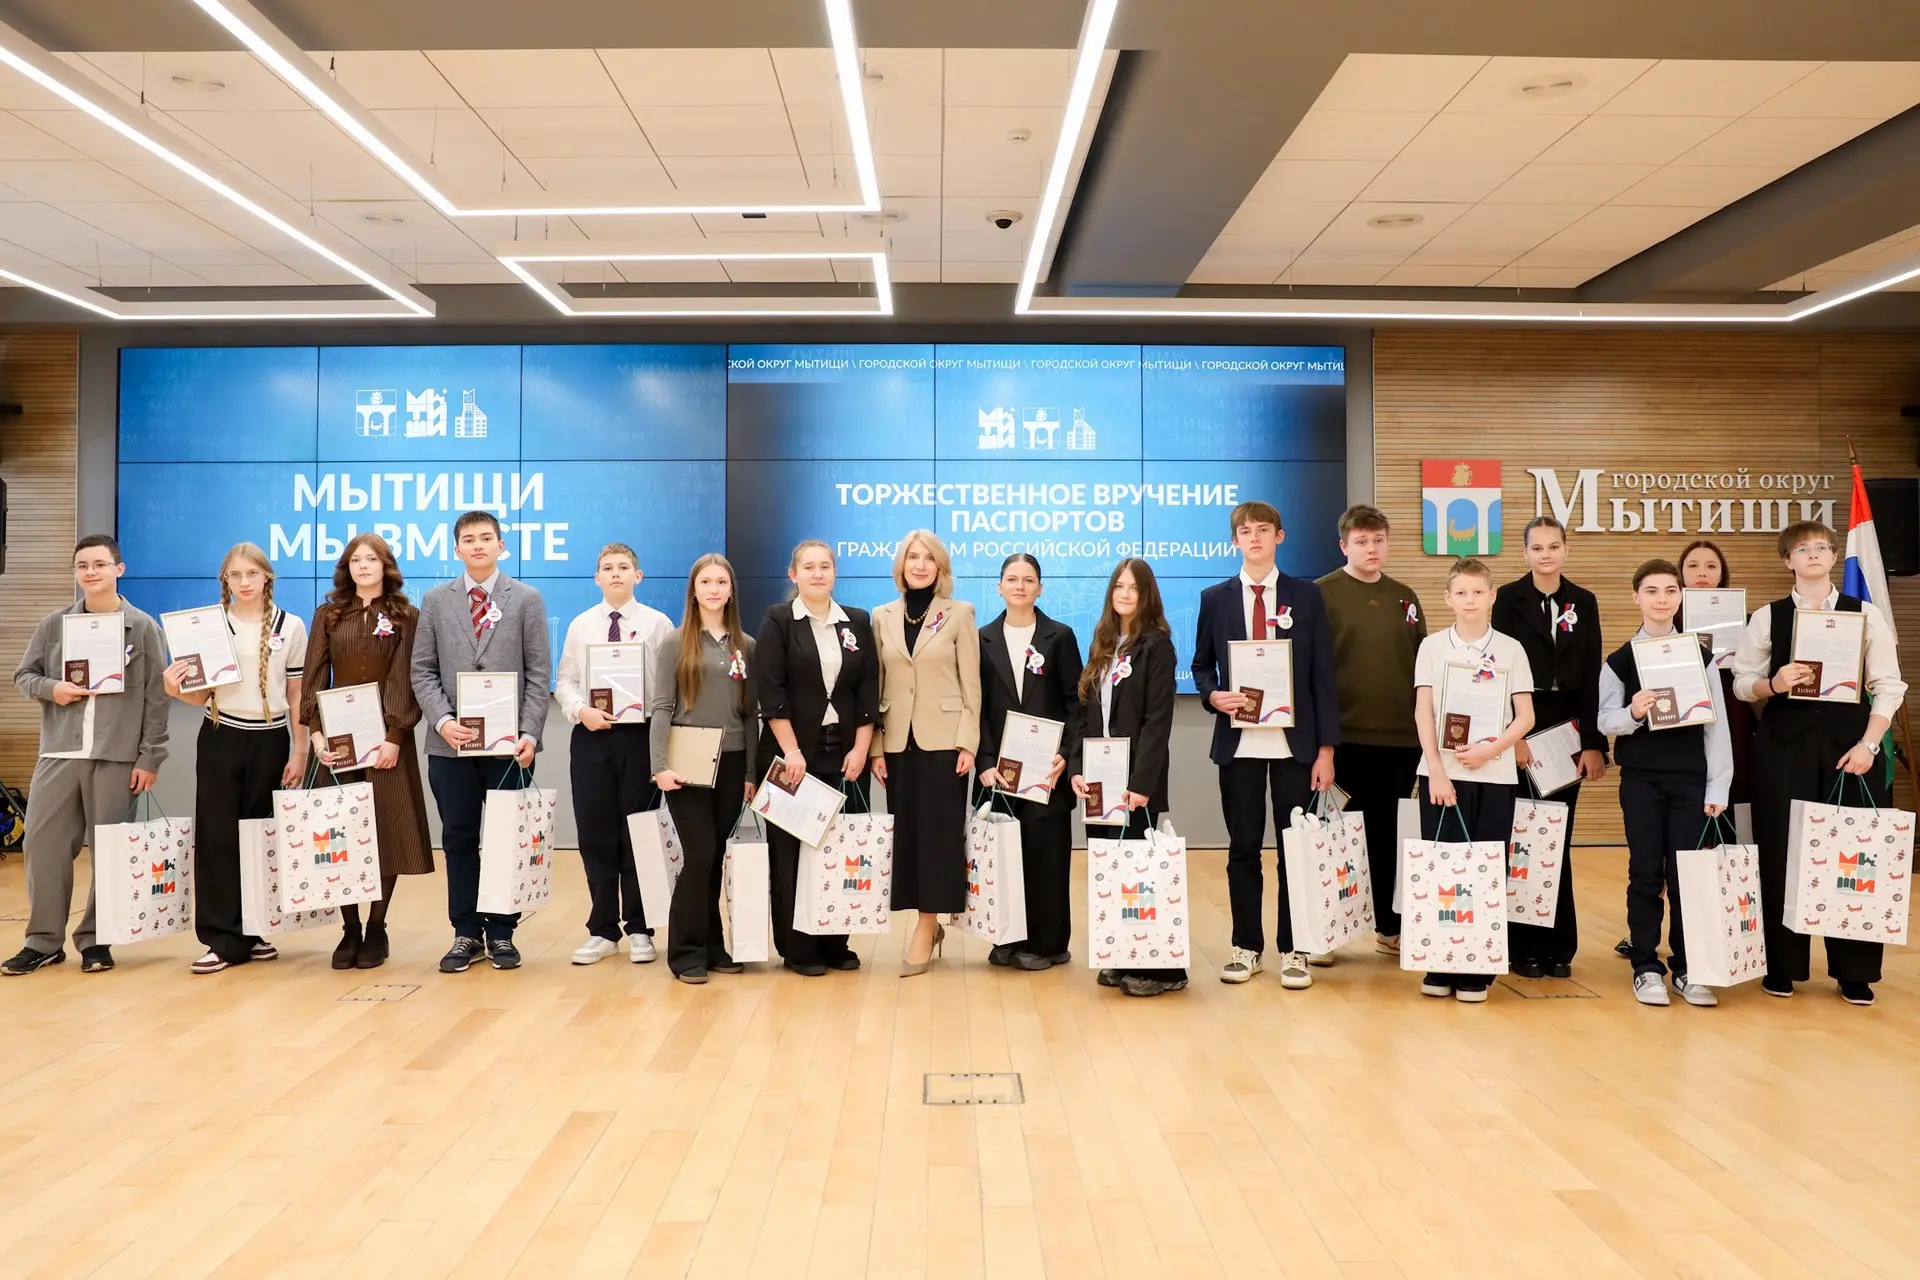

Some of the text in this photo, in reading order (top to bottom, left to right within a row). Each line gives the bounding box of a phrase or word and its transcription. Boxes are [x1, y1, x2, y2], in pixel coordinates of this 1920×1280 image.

[757, 359, 792, 369] ОКРУГ
[795, 360, 848, 371] МЫТИЩИ
[859, 358, 926, 371] ГОРОДСКОЙ
[932, 360, 963, 369] ОКРУГ
[967, 360, 1020, 371] МЫТИЩИ
[1031, 358, 1098, 371] ГОРОДСКОЙ
[1101, 360, 1135, 370] ОКРУГ
[1138, 361, 1192, 372] МЫТИЩИ
[1202, 359, 1268, 372] ГОРОДСКОЙ
[1271, 361, 1305, 371] ОКРУГ
[1612, 467, 1835, 495] городской округ
[294, 472, 544, 518] МЫТИЩИ
[836, 484, 1239, 506] ТОРЖЕСТВЕННОЕ ВРУЧЕНИЕ
[951, 510, 1126, 533] ПАСПОРТОВ
[270, 523, 357, 561] МЫ
[973, 538, 1113, 558] РОССИЙСКОЙ
[1116, 540, 1237, 561] ФЕДЕРАЦИИ
